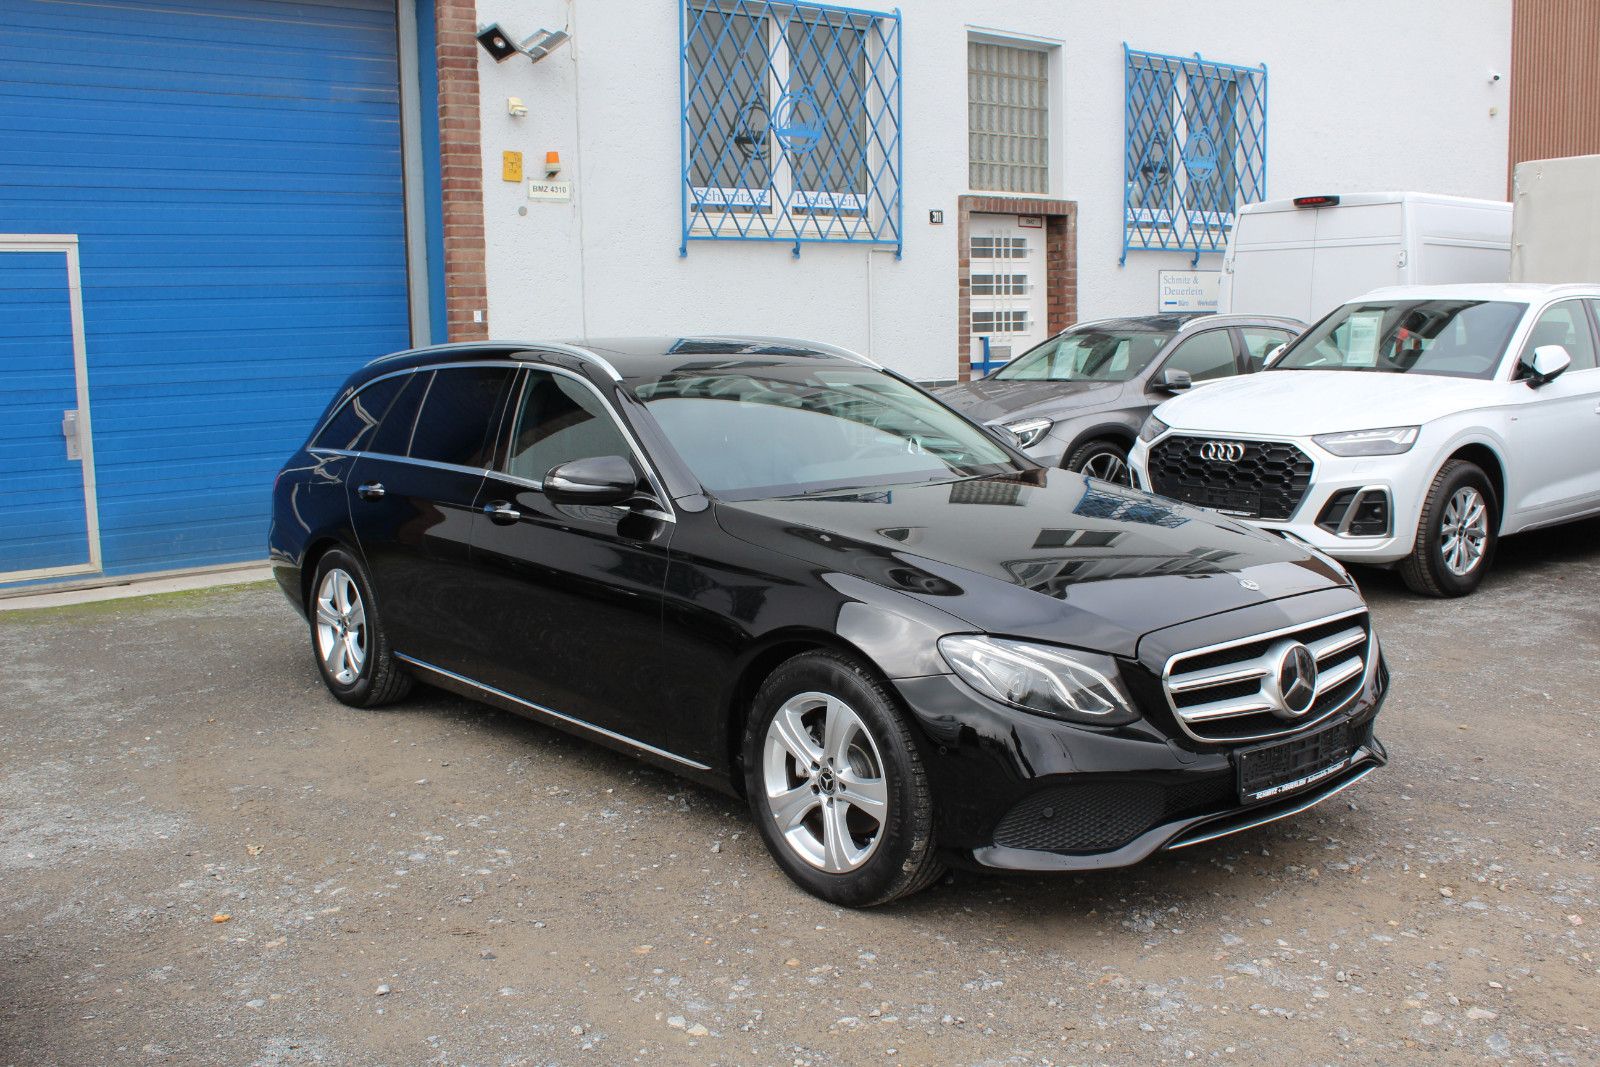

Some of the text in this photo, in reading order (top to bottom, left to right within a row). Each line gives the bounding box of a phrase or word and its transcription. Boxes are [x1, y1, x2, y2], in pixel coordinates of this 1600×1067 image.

[532, 185, 567, 194] BMZ 4310
[755, 191, 768, 203] &
[1163, 275, 1200, 285] Schmitz &
[1164, 287, 1203, 296] Deuerlein
